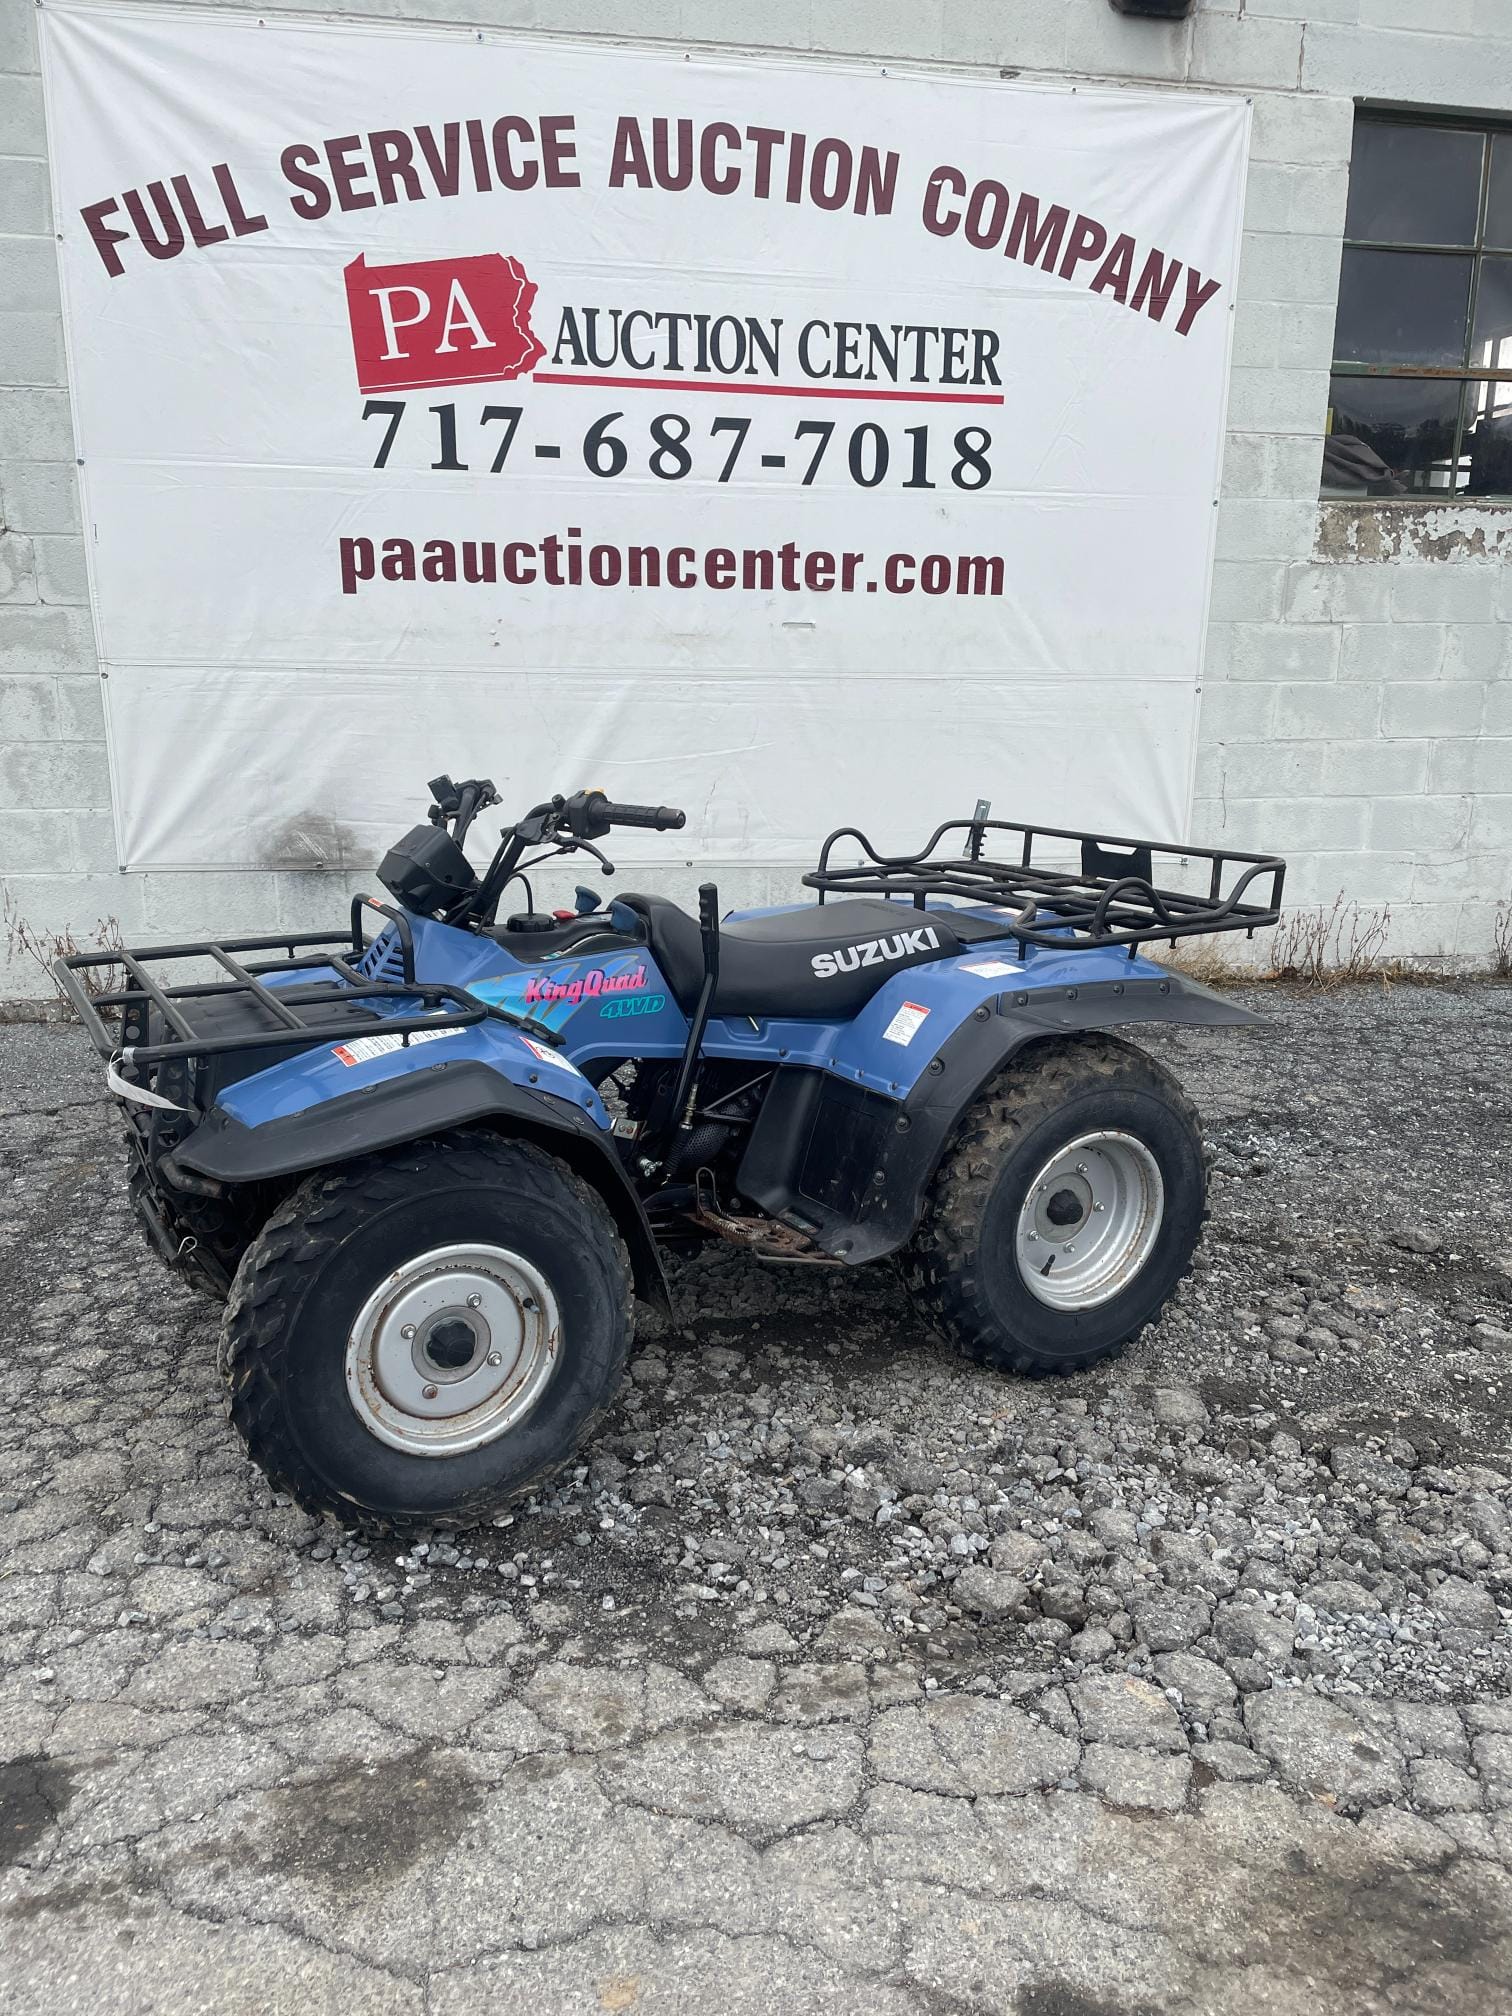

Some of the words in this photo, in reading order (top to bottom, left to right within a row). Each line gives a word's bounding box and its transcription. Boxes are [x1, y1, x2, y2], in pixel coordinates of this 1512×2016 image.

[80, 163, 269, 278] FULL
[280, 115, 581, 220] SERVICE
[608, 116, 900, 216] AUCTION
[922, 165, 1222, 337] COMPANY
[368, 278, 497, 361] PA
[551, 306, 783, 377] AUCTION
[797, 319, 1002, 386] CENTER
[361, 400, 992, 490] 717-687-7018
[339, 527, 1005, 596] paauctioncenter.com
[811, 926, 941, 978] SUZUKI
[600, 994, 665, 1018] 4WD
